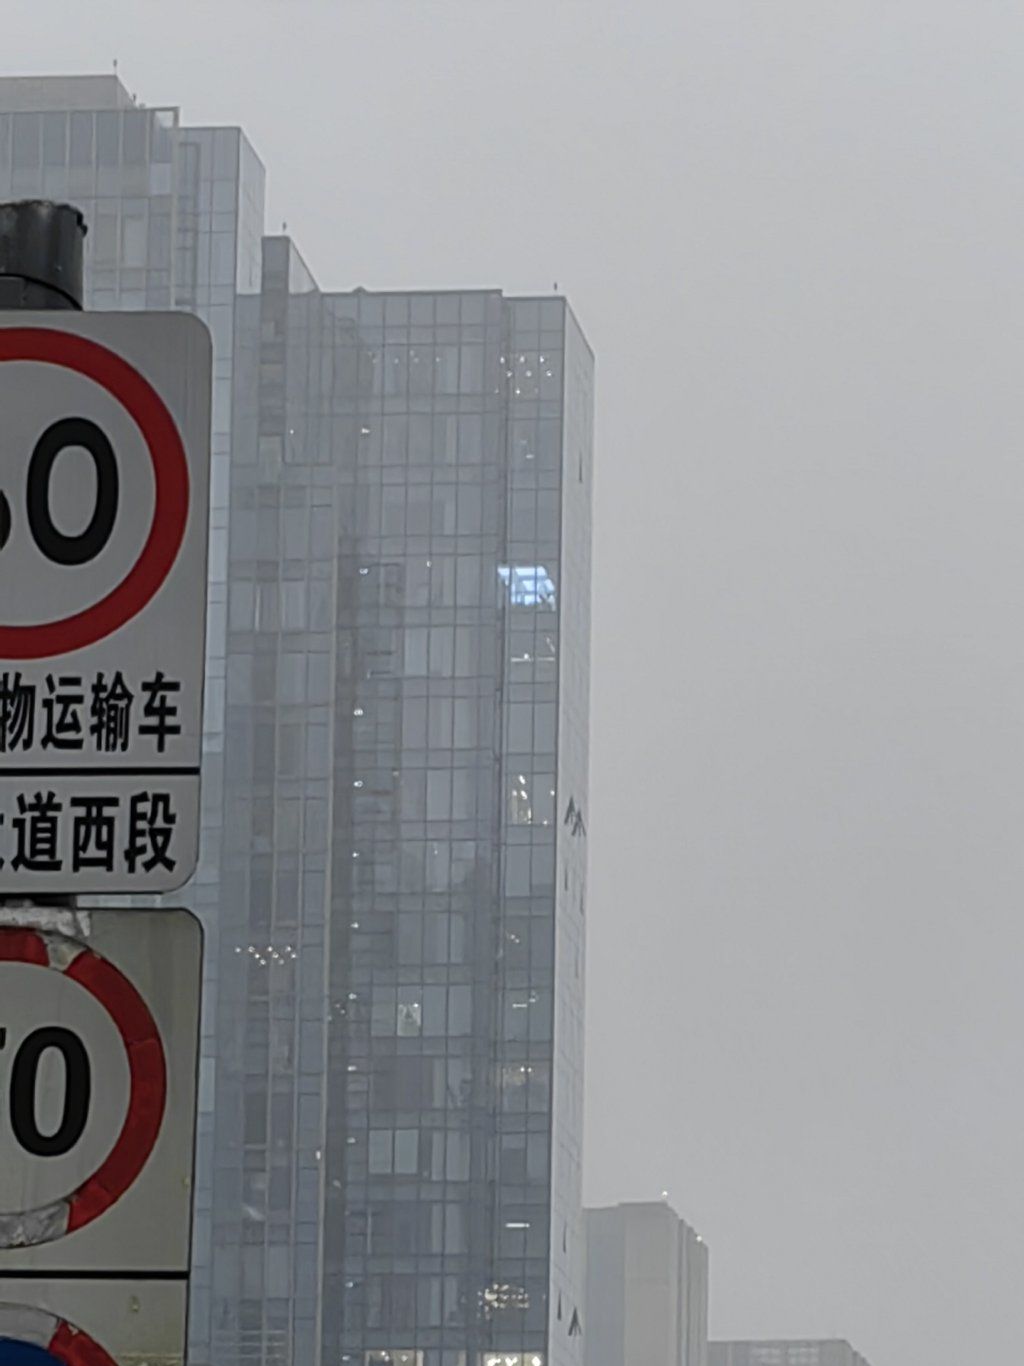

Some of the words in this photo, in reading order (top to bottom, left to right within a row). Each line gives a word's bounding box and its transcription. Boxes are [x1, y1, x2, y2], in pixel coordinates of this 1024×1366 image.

[0, 417, 119, 566] 0
[0, 671, 181, 753] 物运输车
[0, 790, 176, 874] 道西段
[0, 1026, 91, 1157] 0
